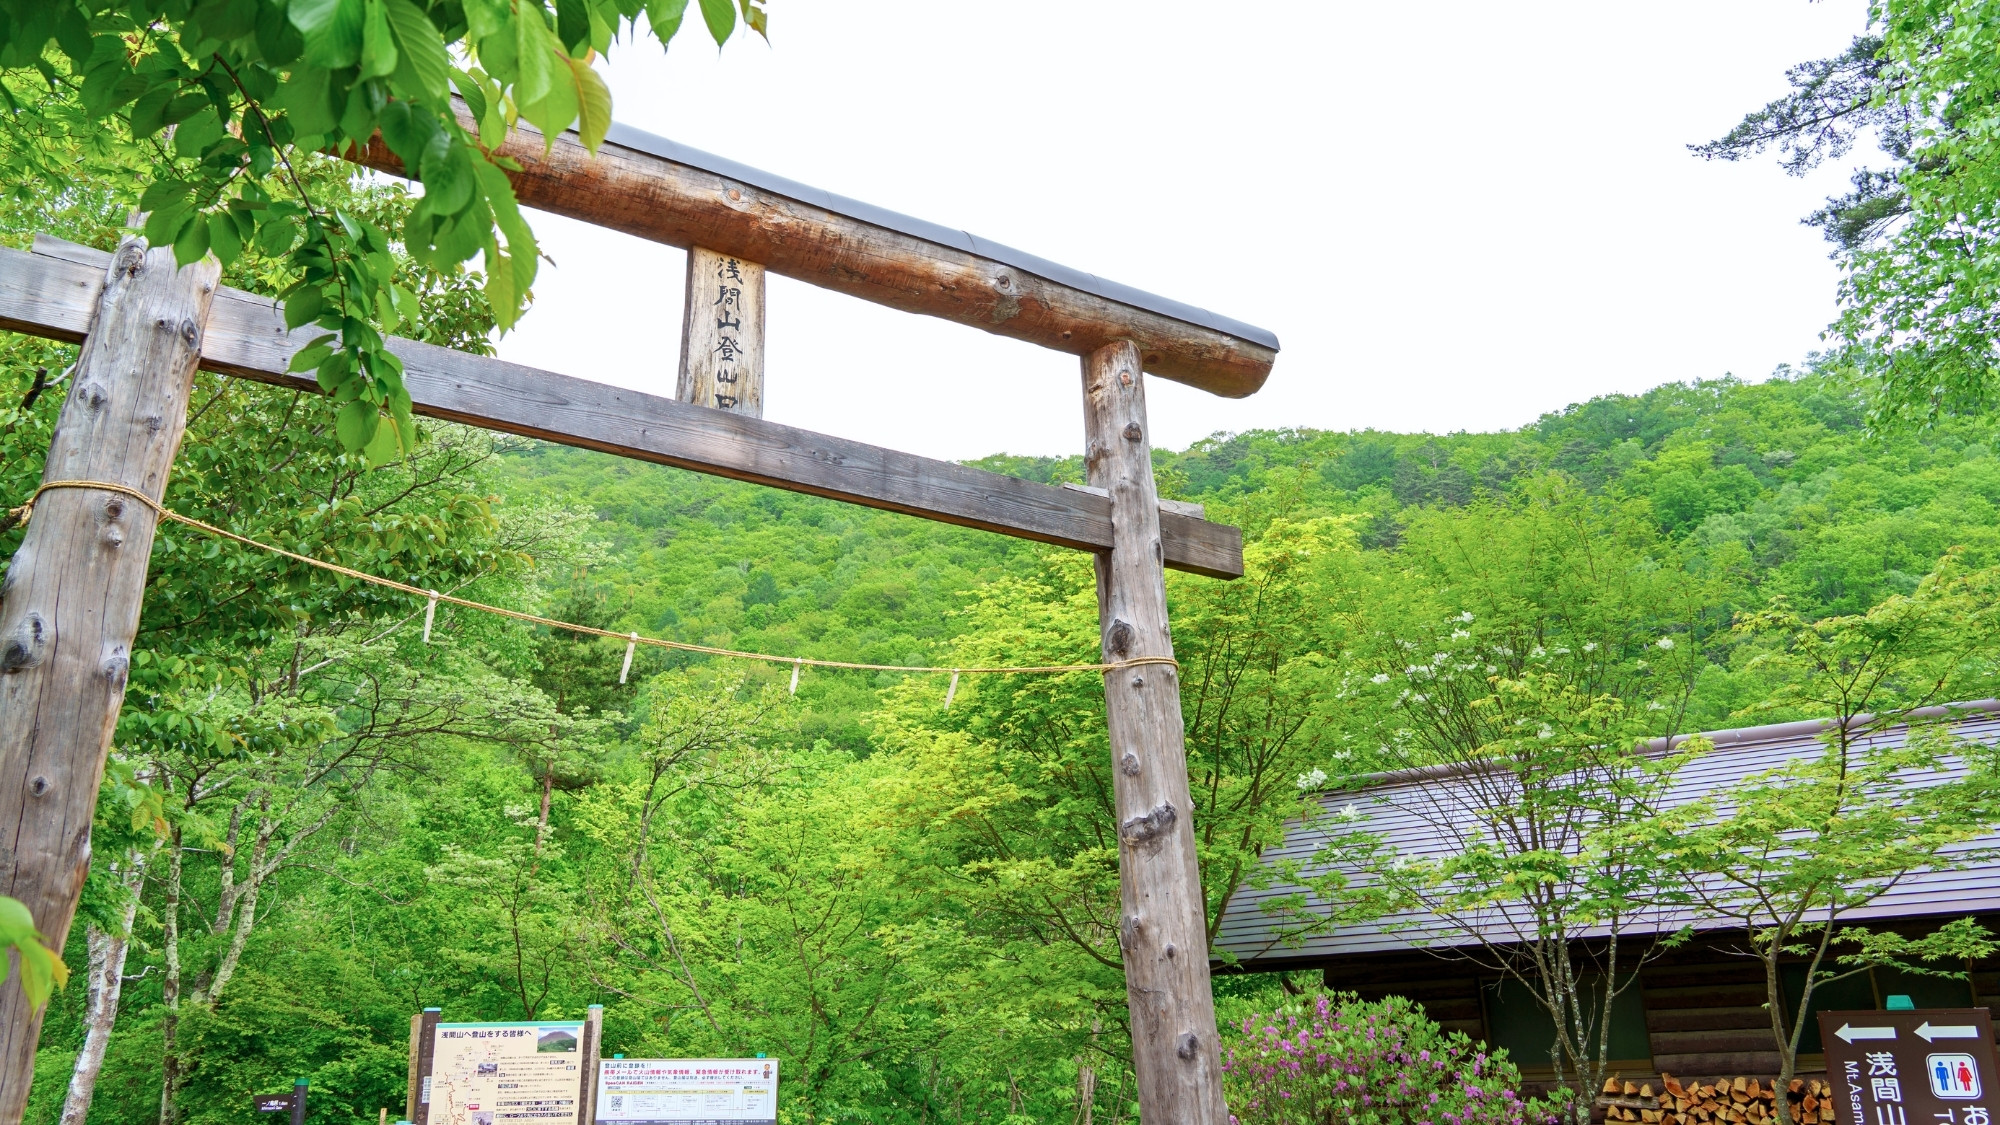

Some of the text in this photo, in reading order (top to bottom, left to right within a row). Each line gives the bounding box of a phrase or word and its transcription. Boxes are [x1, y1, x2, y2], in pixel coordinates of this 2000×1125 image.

[713, 256, 744, 410] 浅間山登山口
[441, 1029, 532, 1039] 浅間山へ登山をする皆様へ
[1844, 1060, 1865, 1125] Mt.Asam
